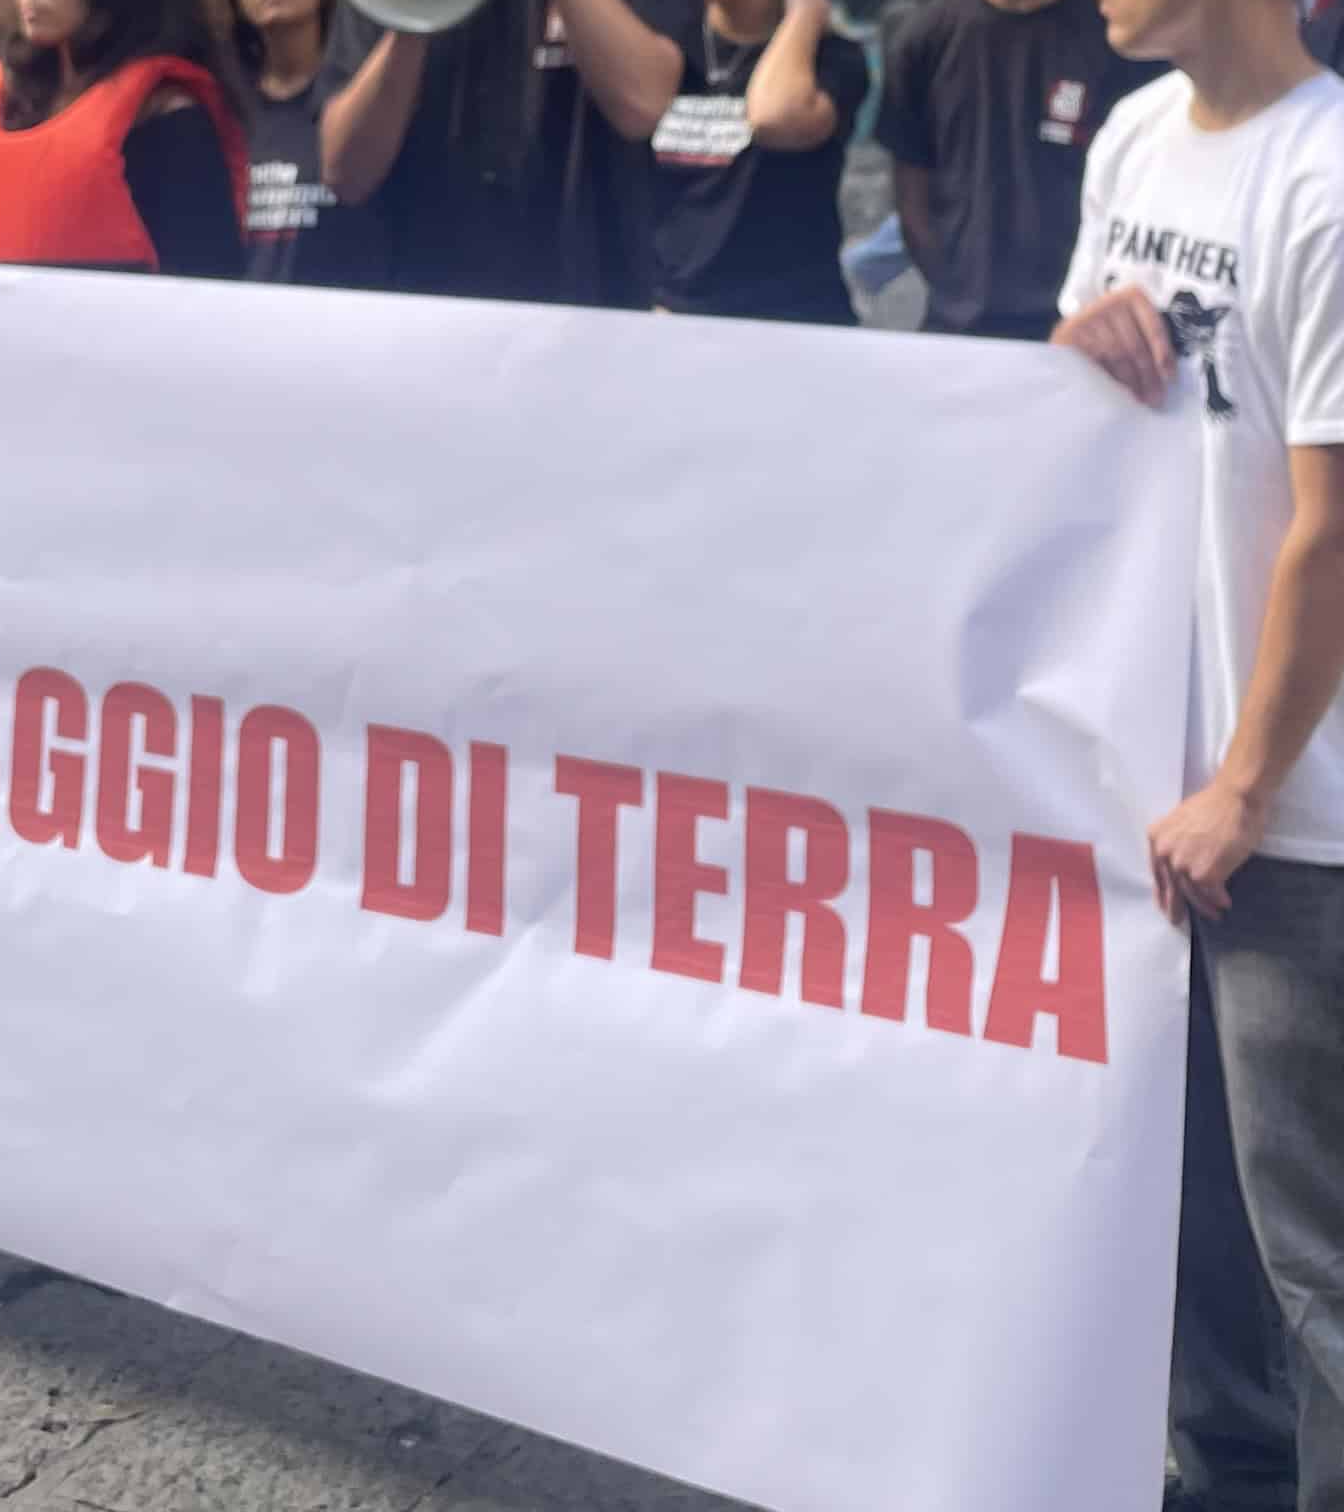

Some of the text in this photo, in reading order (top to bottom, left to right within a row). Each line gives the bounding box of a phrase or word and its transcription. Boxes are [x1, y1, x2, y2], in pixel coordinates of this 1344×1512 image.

[1106, 218, 1239, 288] PANTHER
[359, 722, 510, 938] DI
[553, 753, 1111, 1066] TERRA
